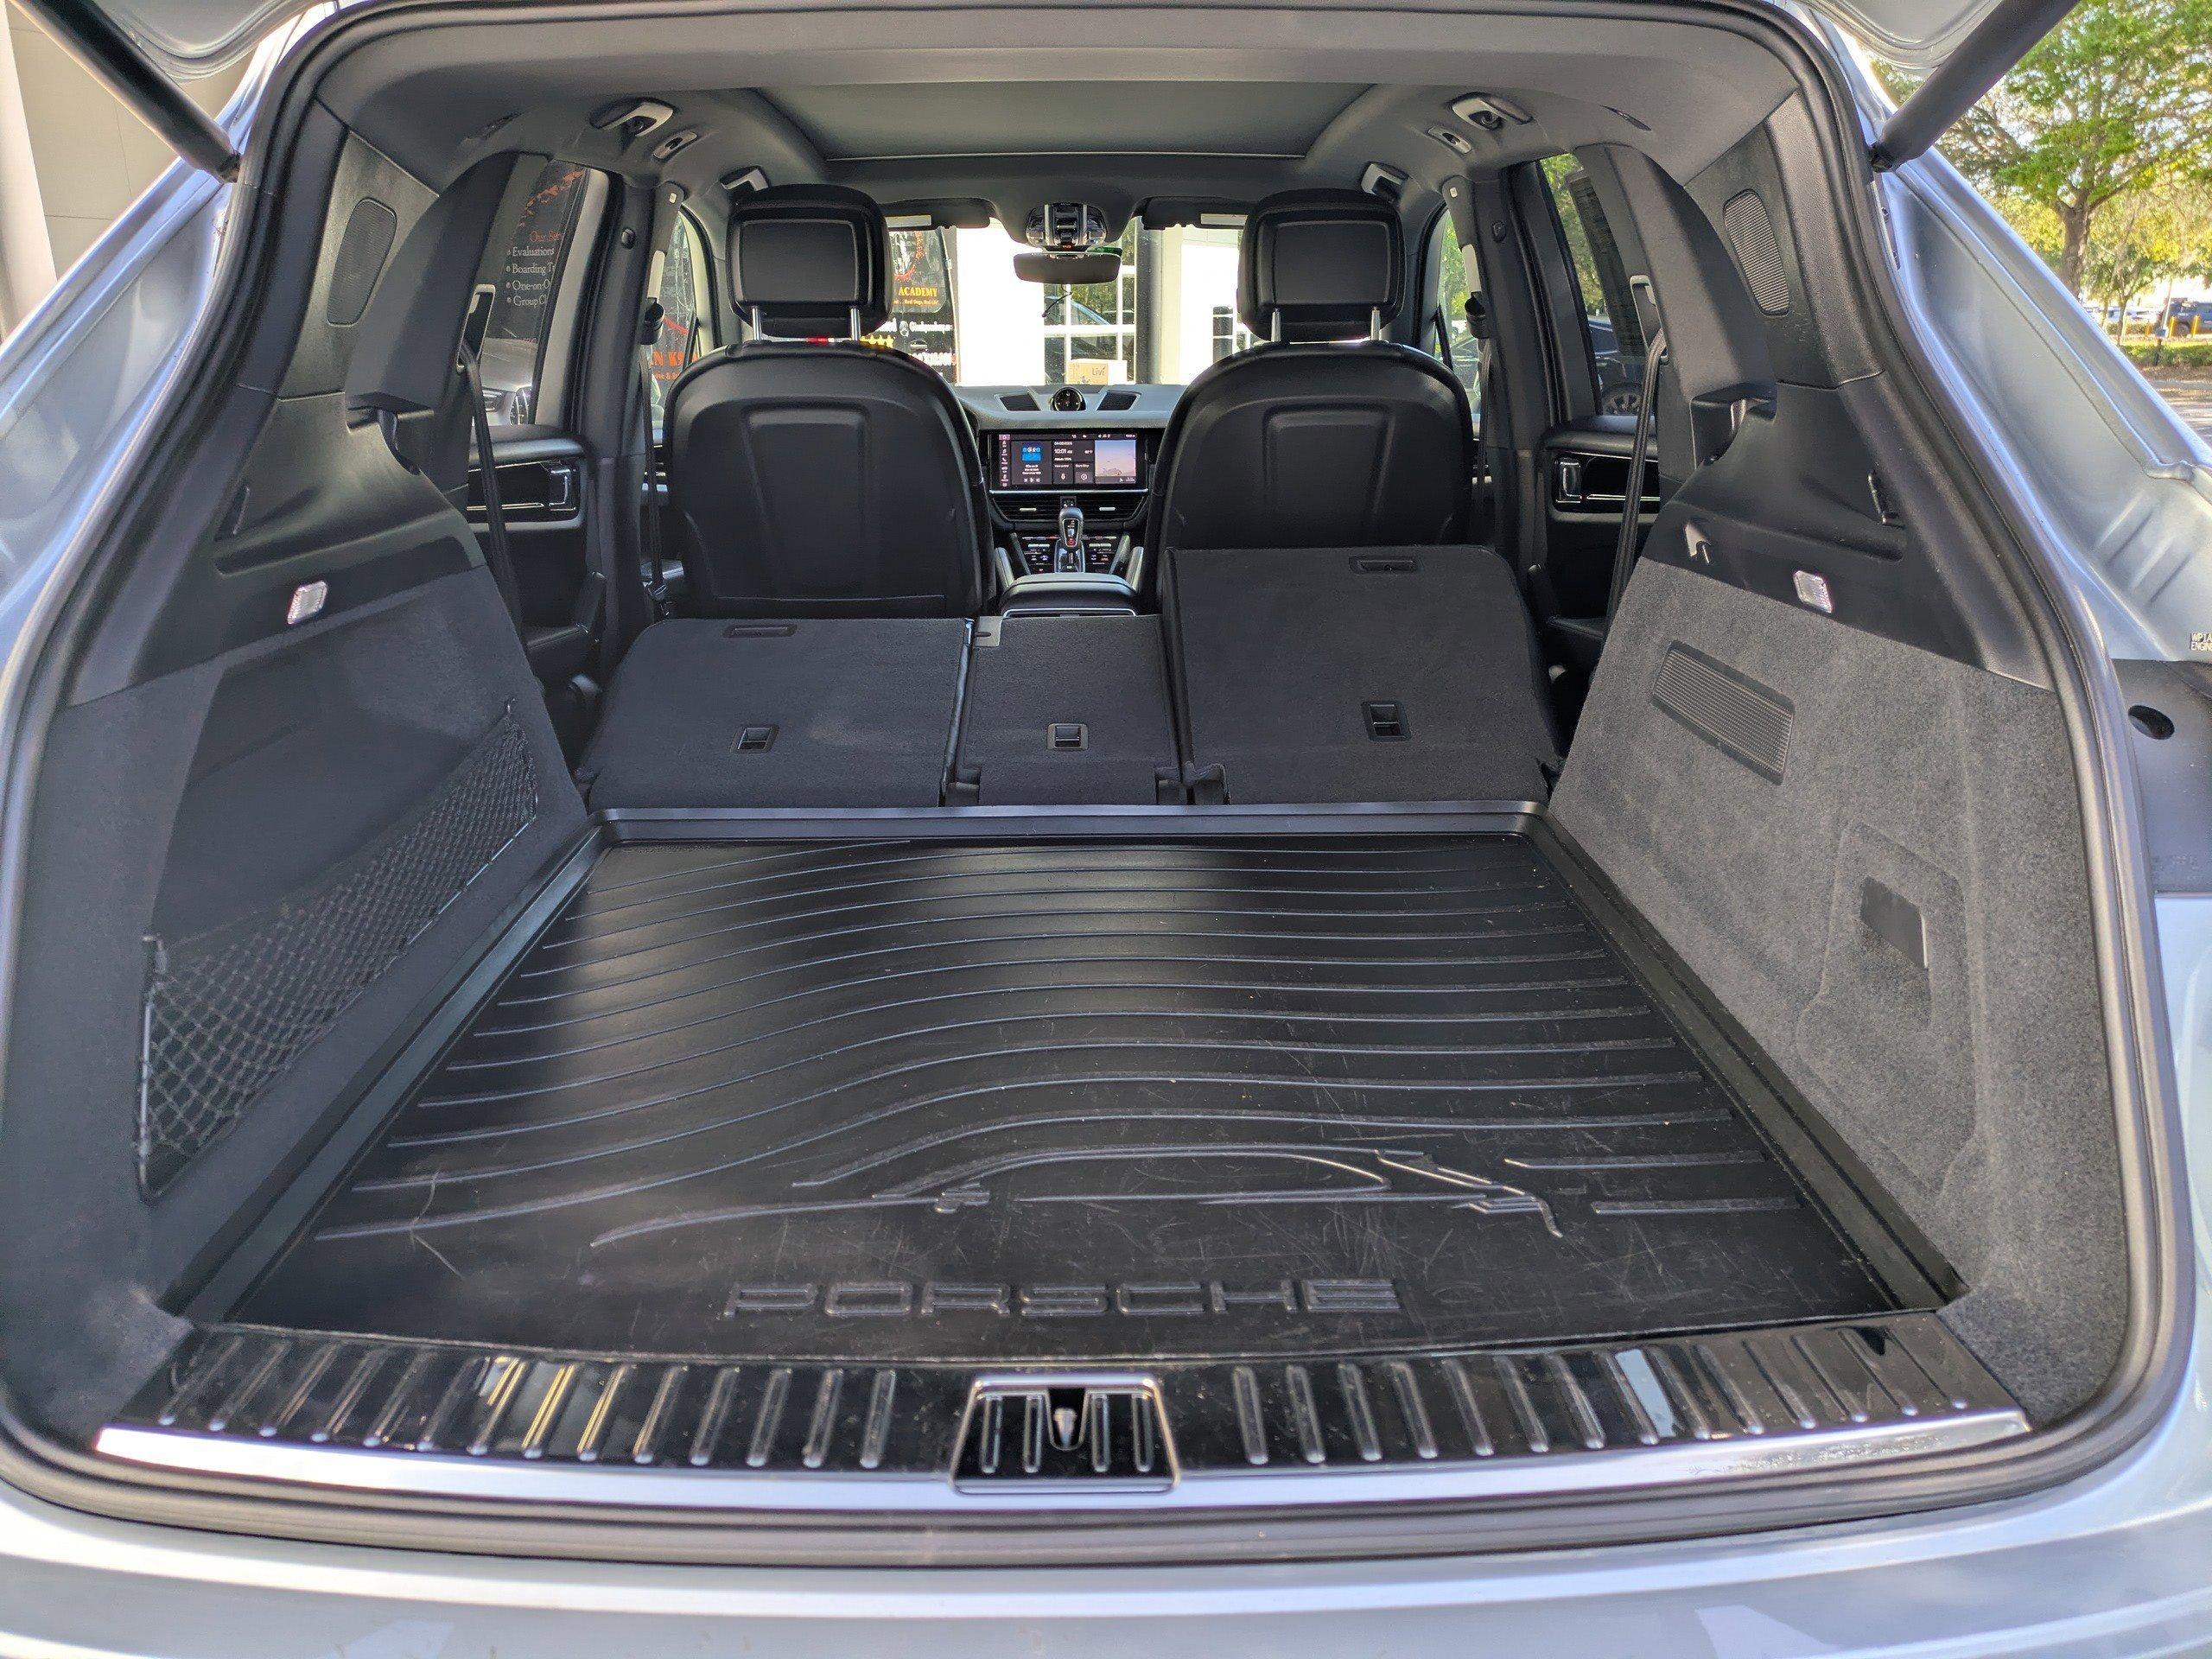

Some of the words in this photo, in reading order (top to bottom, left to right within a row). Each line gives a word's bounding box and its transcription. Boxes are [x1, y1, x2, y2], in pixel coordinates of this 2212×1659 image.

[512, 246, 555, 257] Evaluations
[512, 263, 546, 276] Boarding
[899, 286, 938, 297] ACADEMY
[513, 295, 538, 308] Group
[723, 1279, 1402, 1317] PORSCHE
